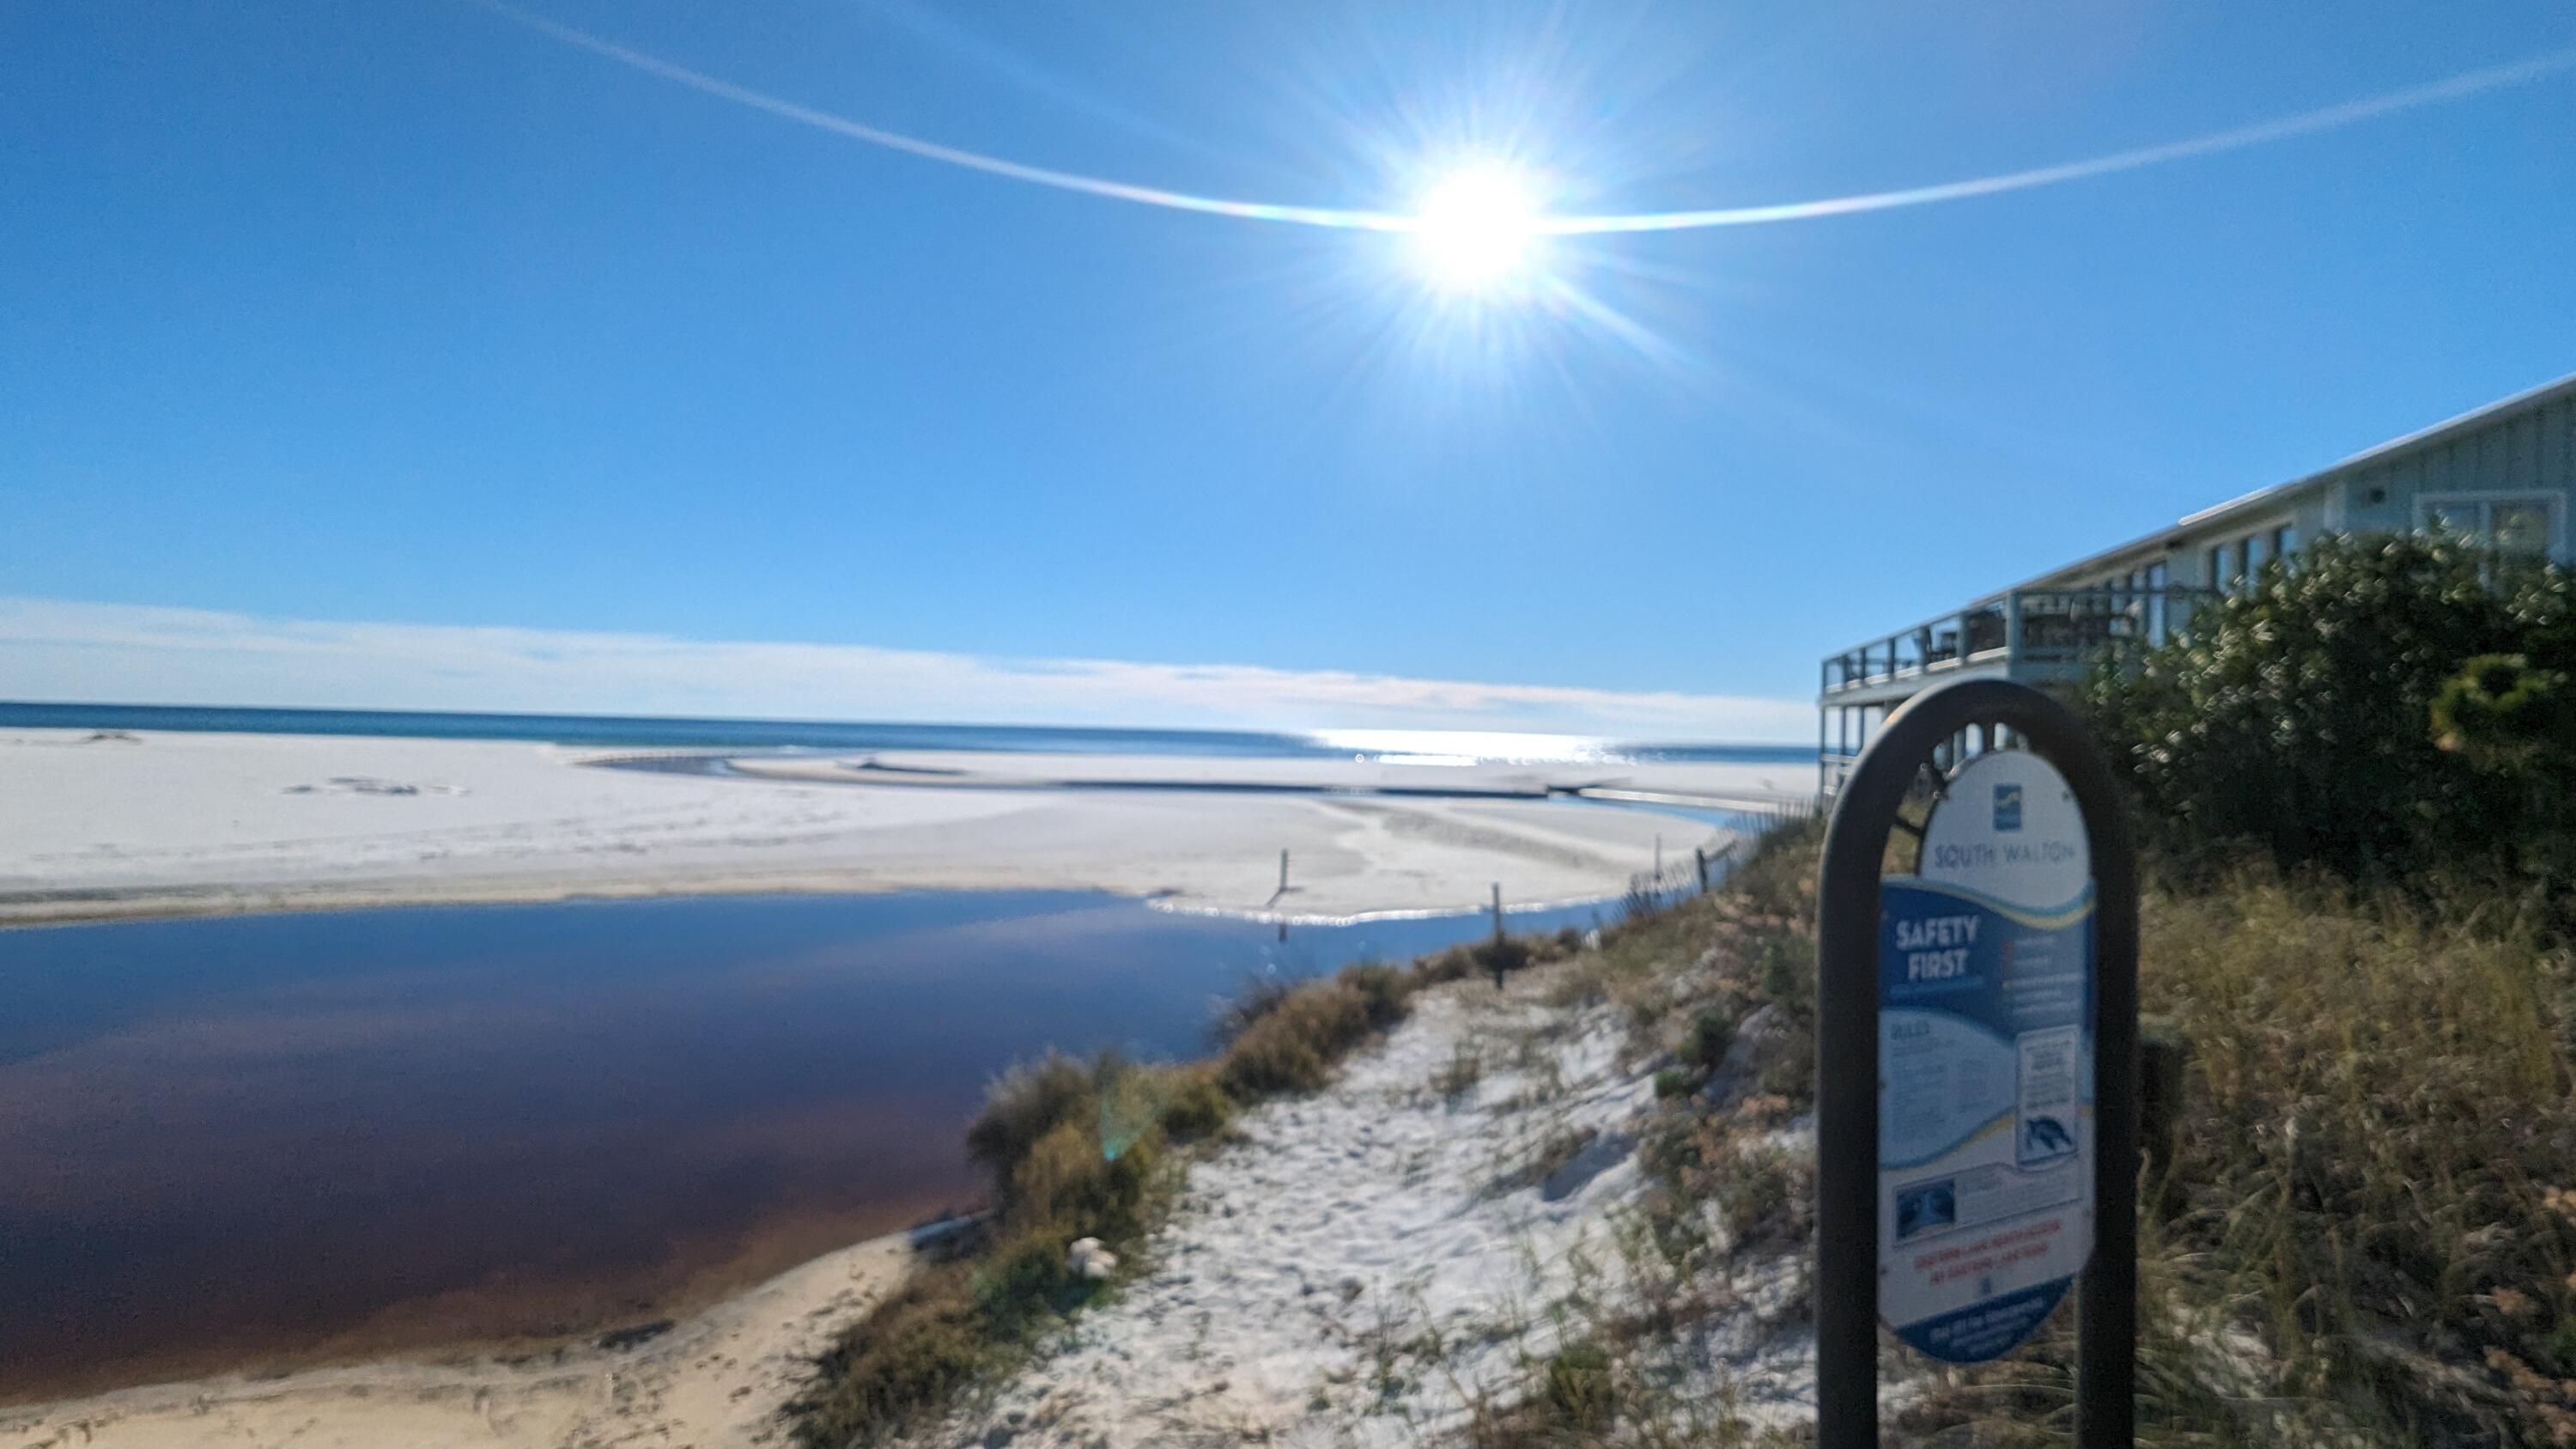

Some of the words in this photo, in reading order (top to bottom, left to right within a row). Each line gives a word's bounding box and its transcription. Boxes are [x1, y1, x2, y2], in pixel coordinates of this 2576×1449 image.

[1934, 843, 1997, 868] SOUTH
[1895, 914, 1980, 951] SAFETY
[1908, 947, 1968, 982] FIRST
